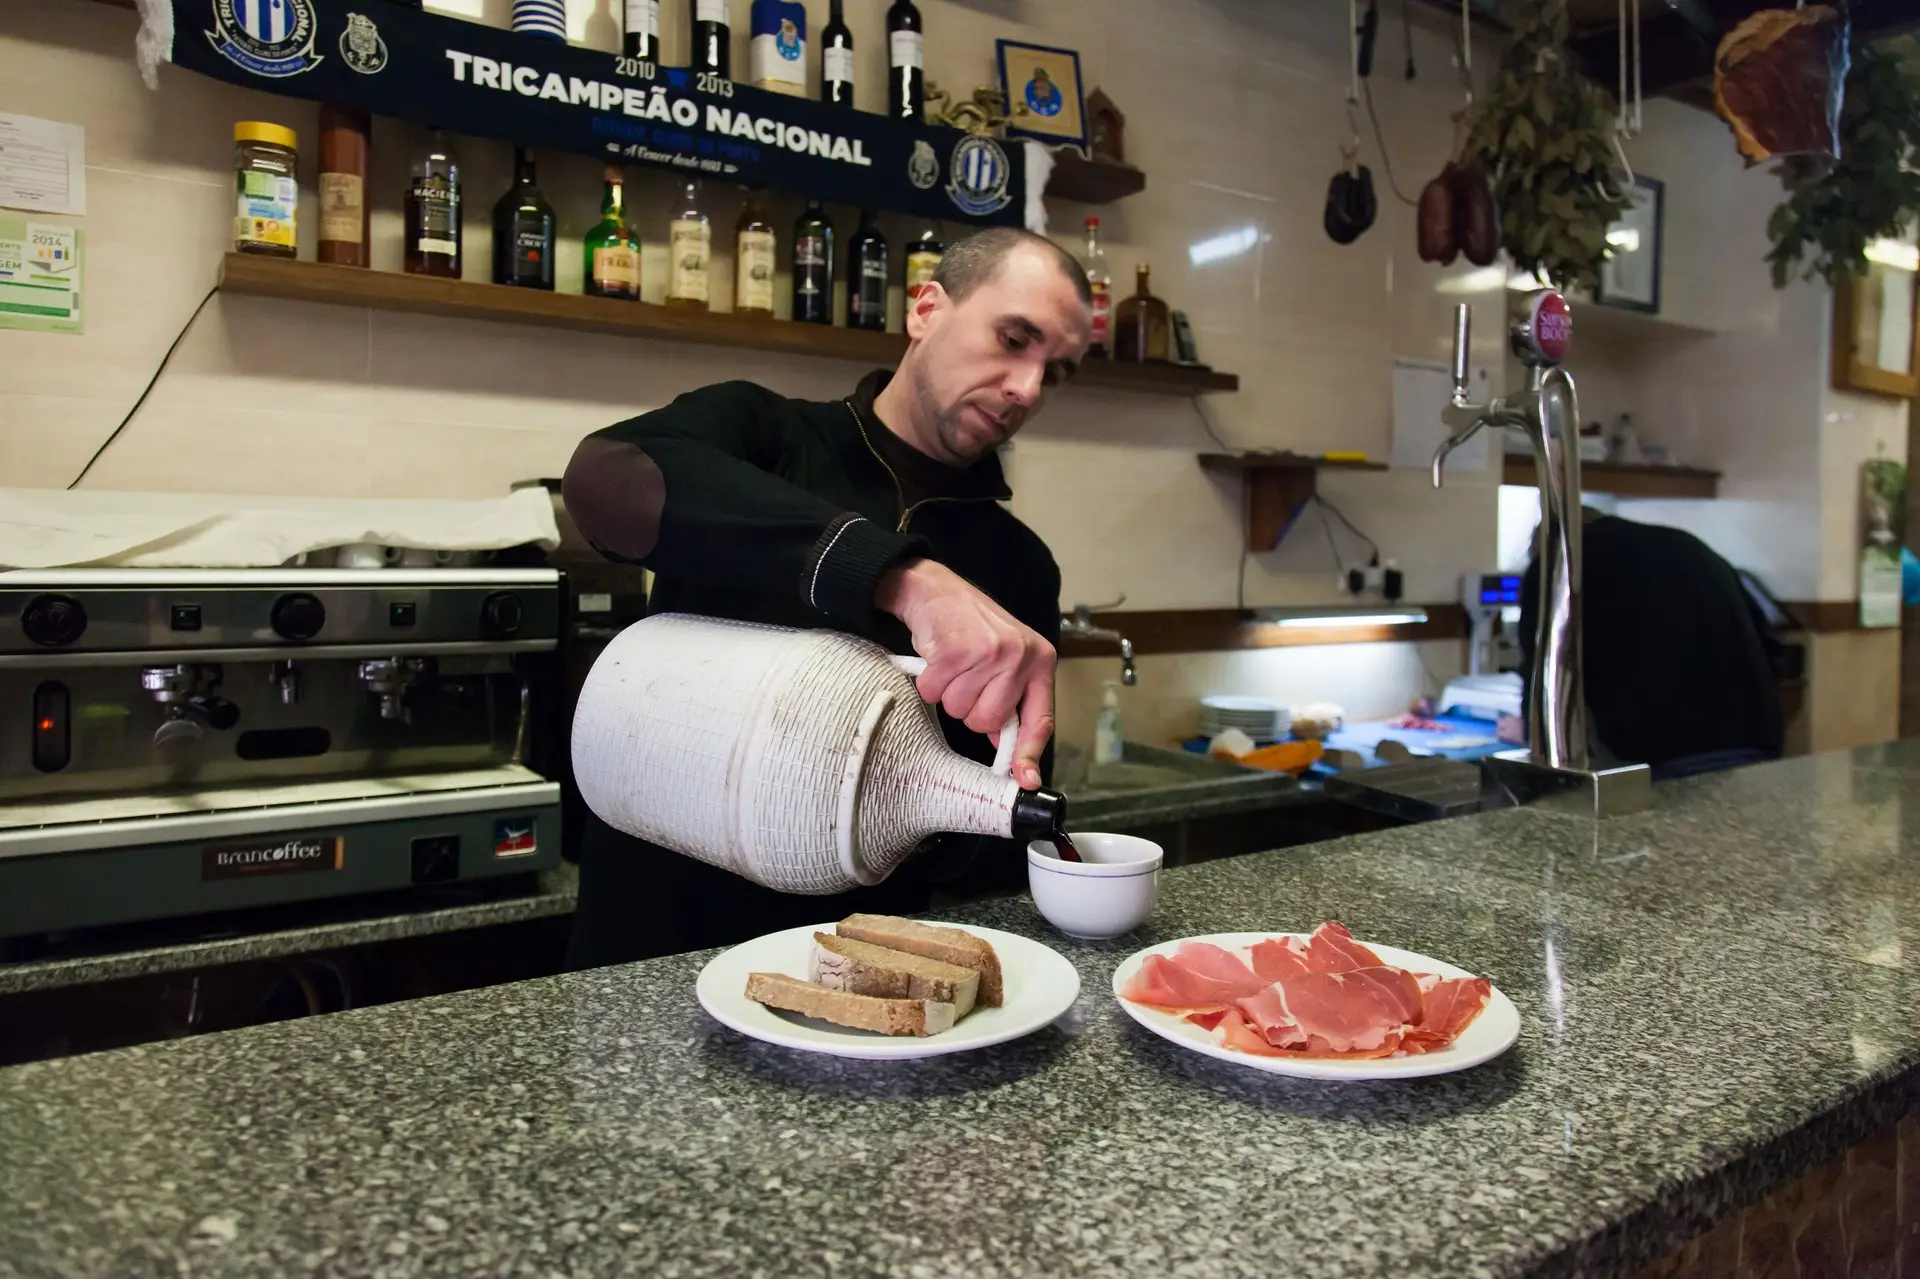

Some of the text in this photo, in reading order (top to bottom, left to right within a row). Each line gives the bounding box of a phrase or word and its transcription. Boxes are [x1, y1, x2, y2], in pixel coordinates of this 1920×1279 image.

[615, 56, 656, 80] 2010
[696, 72, 734, 98] 2013
[446, 49, 698, 127] TRICAMPEÃO
[706, 105, 872, 166] NACIONAL
[32, 234, 63, 247] 2014
